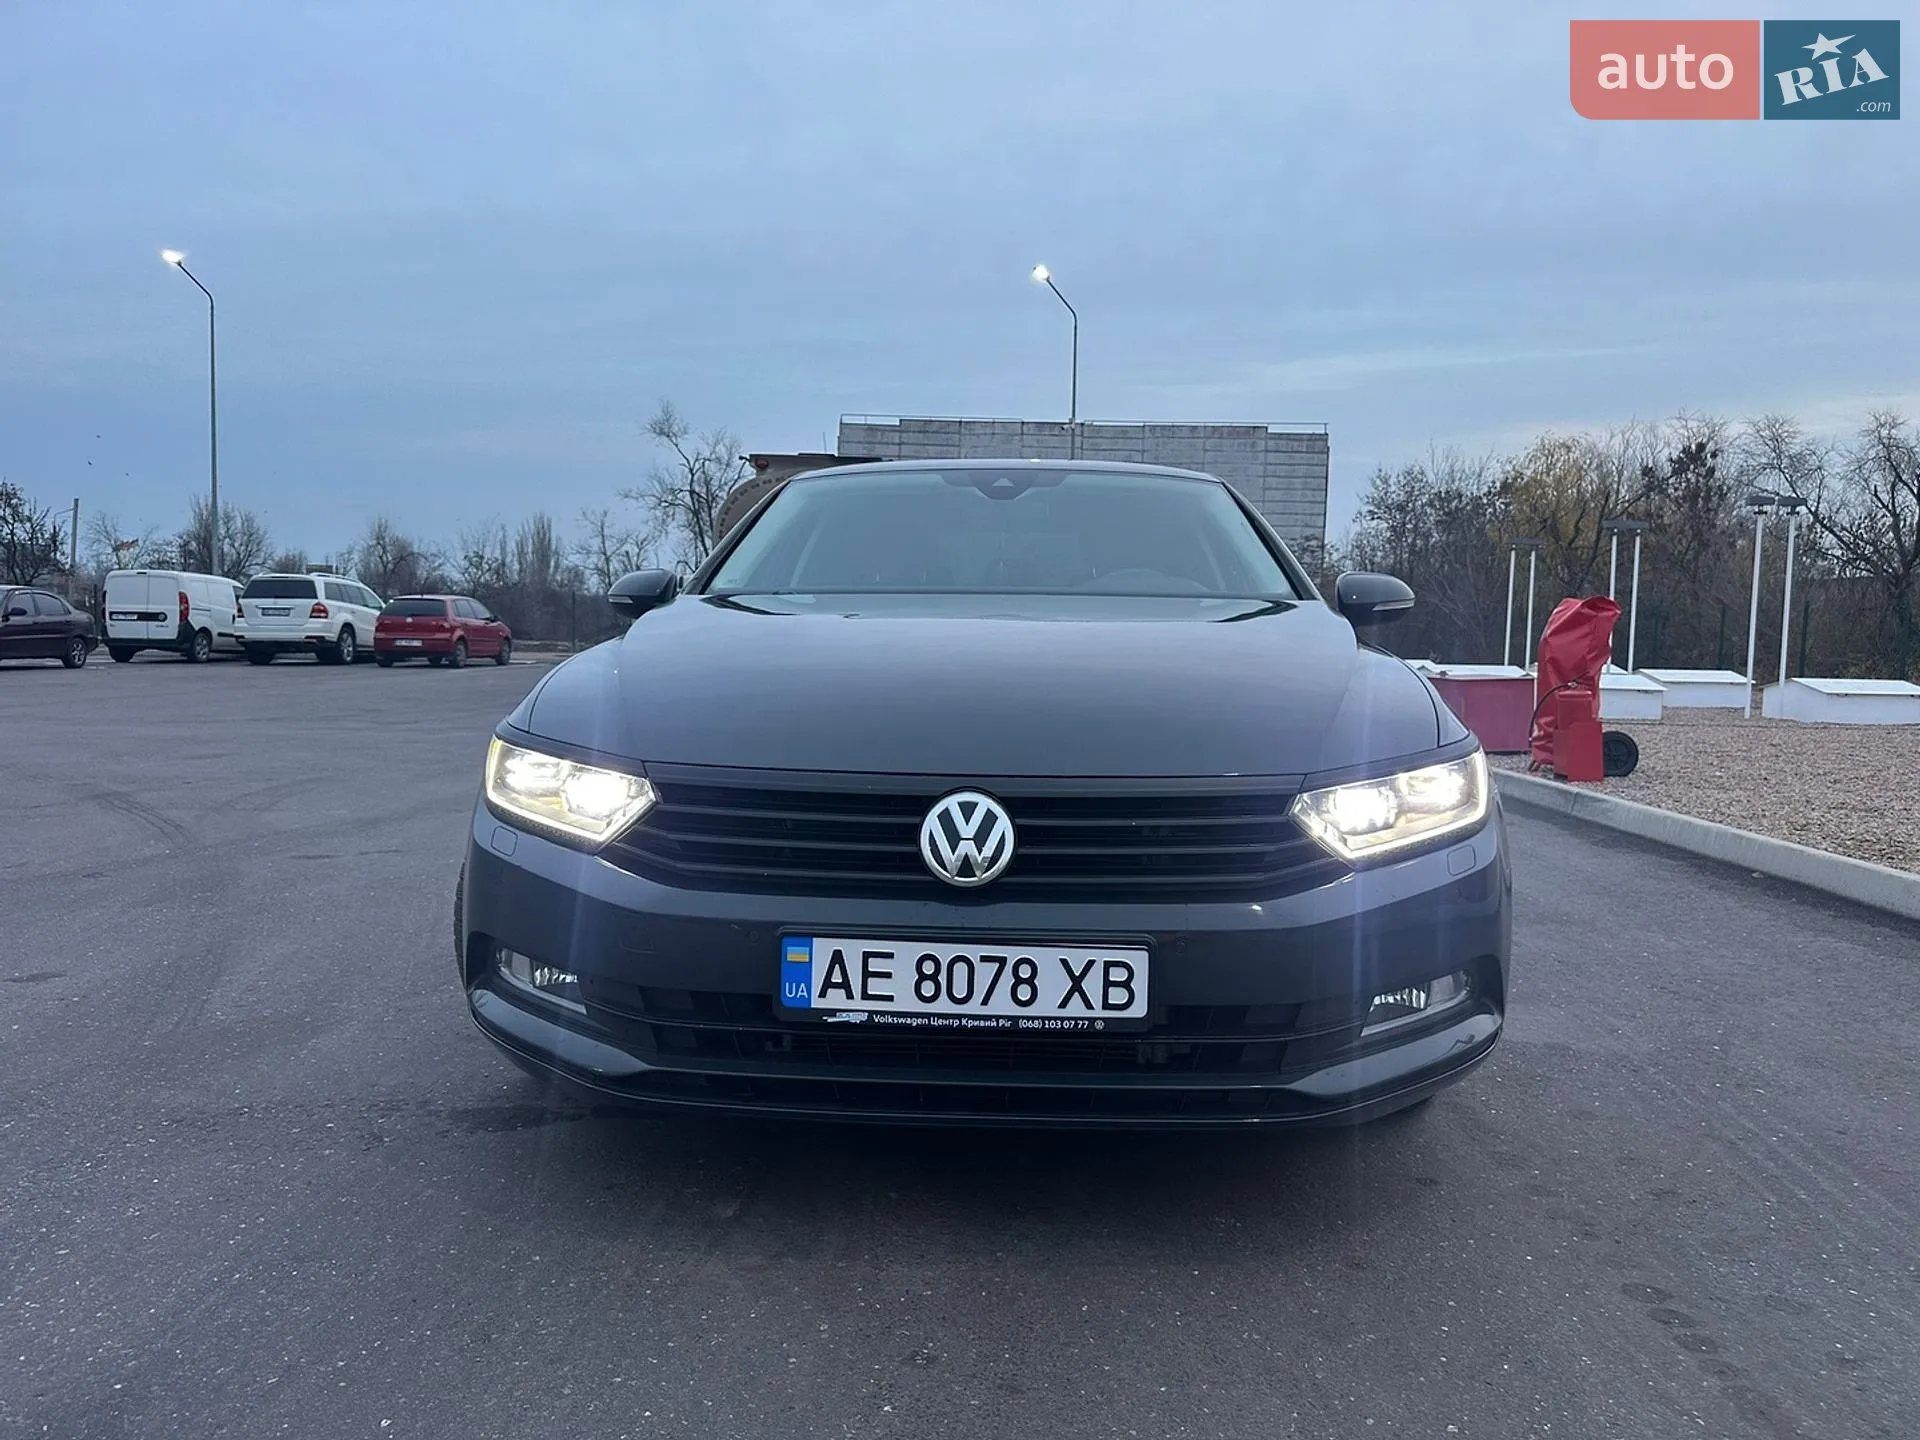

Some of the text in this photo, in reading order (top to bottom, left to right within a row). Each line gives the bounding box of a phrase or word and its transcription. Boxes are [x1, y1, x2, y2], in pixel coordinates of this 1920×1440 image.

[817, 948, 1135, 1012] AE 8078 XB
[785, 982, 808, 999] UA
[873, 1014, 928, 1026] Volkswagen
[930, 1017, 960, 1028] Центр
[961, 1017, 997, 1028] Кривий
[1018, 1019, 1042, 1029] (068)
[1044, 1020, 1061, 1029] 103
[1063, 1020, 1075, 1029] 07
[1077, 1020, 1089, 1029] 77
